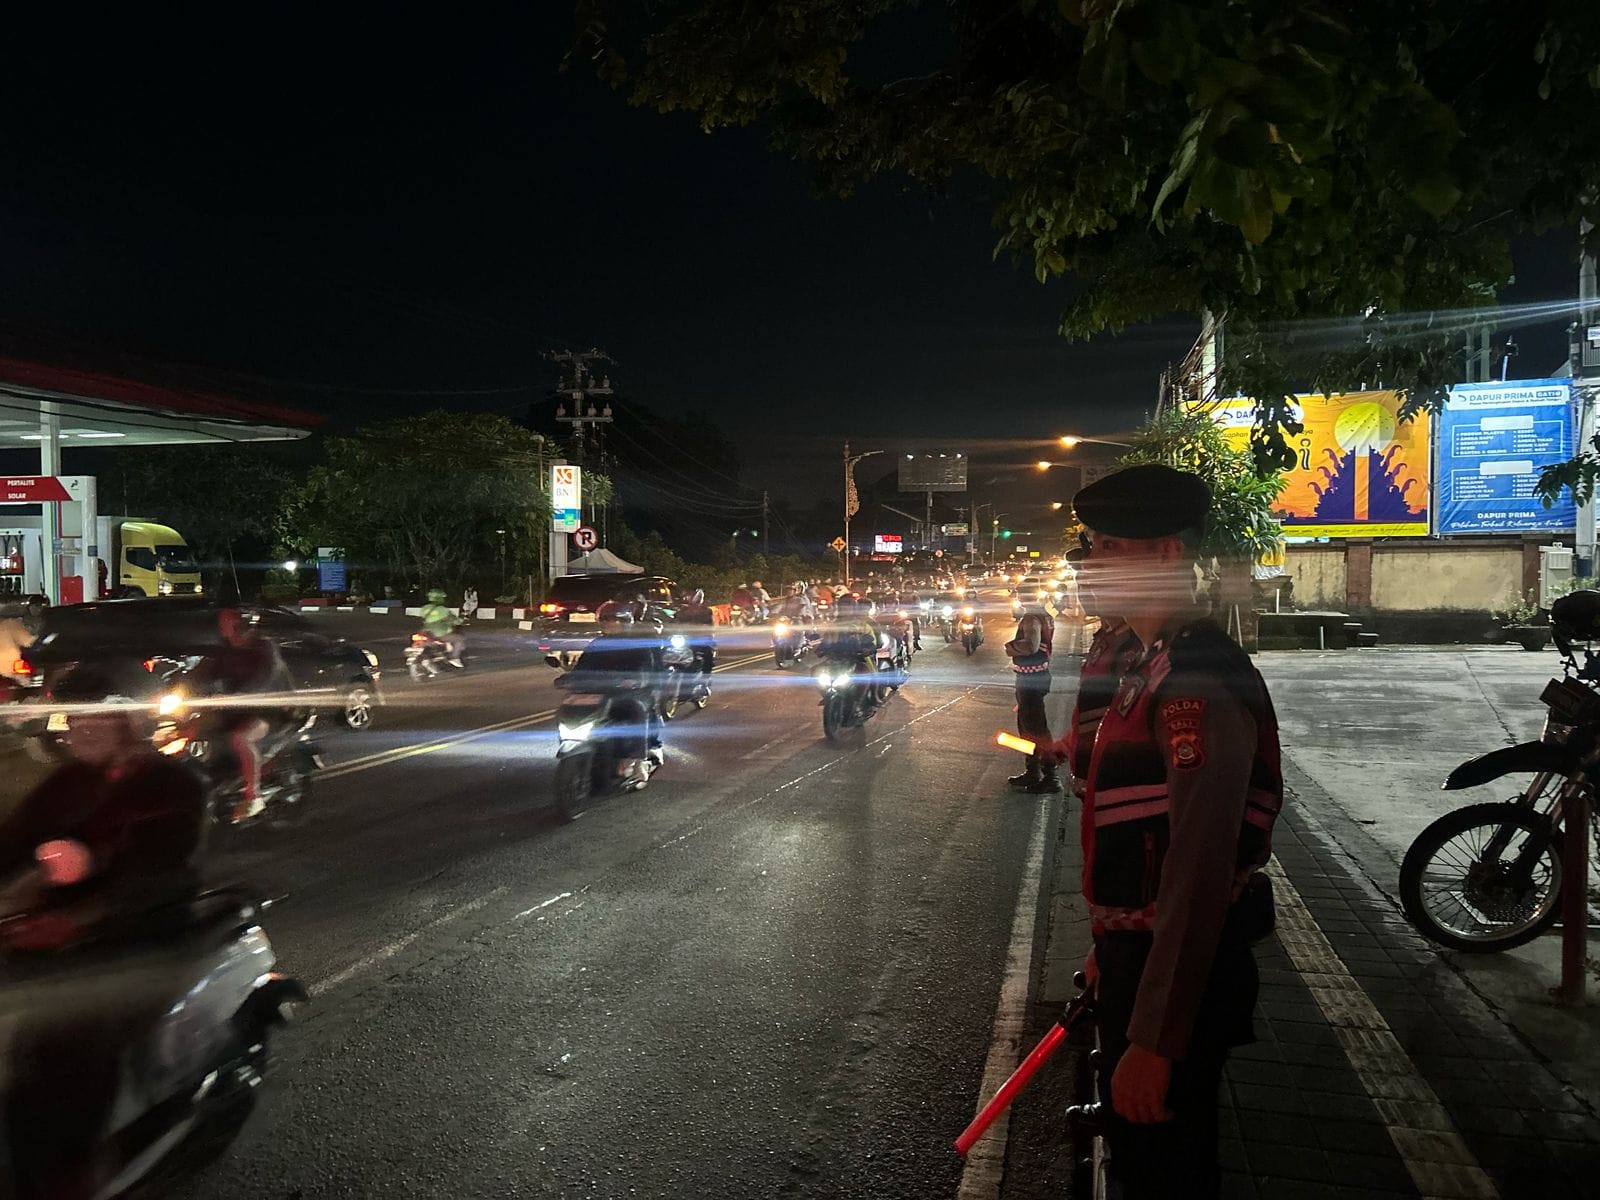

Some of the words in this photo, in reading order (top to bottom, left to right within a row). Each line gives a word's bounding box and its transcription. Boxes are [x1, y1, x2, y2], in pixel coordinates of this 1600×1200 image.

[1469, 393, 1502, 402] DAPUR
[1504, 391, 1534, 400] PRIMA
[1162, 700, 1200, 718] POLDA
